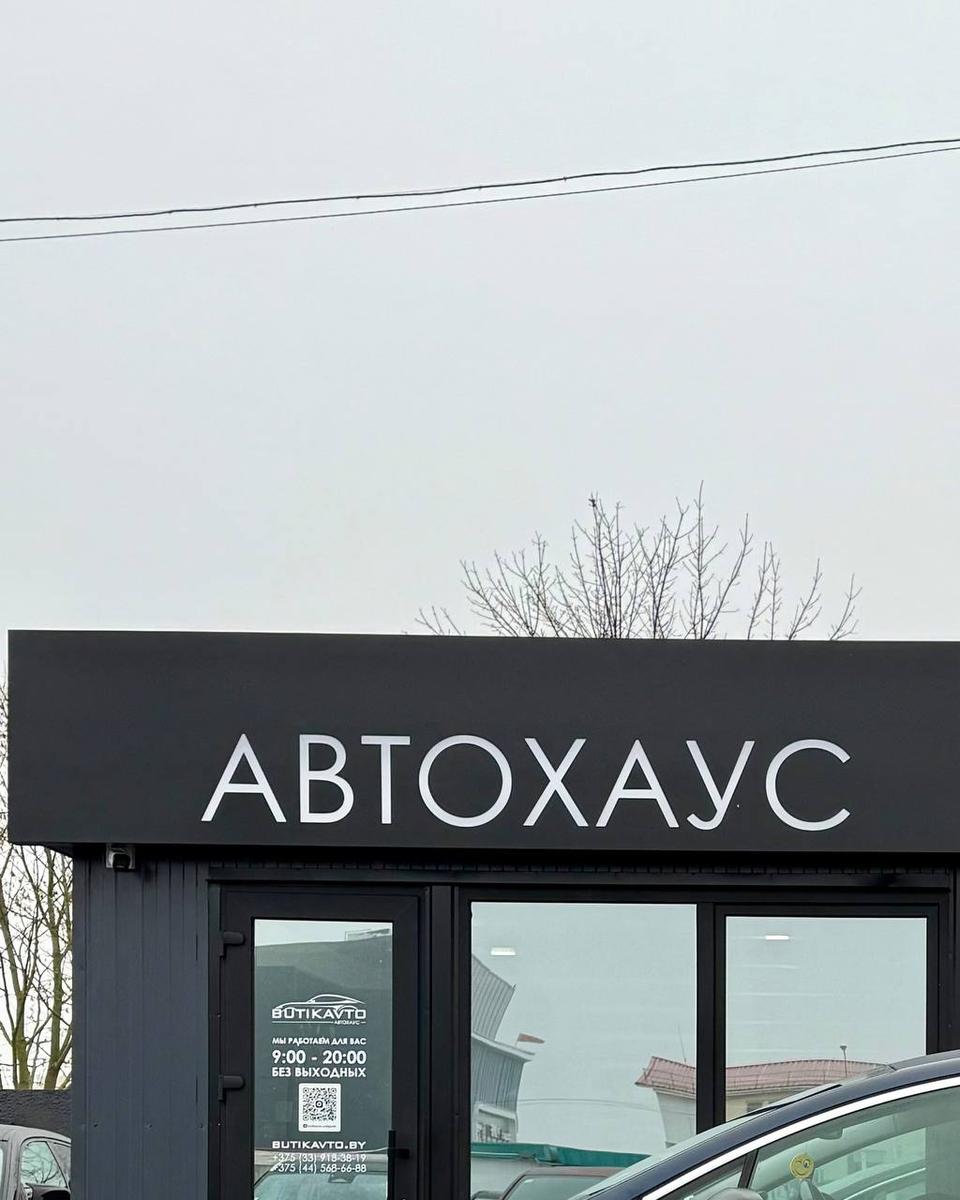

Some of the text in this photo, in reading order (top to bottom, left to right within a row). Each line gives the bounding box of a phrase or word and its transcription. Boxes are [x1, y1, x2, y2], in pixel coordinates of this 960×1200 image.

[201, 733, 851, 831] АВТОХАУС
[272, 1008, 366, 1019] BUTIKAVTO
[272, 1037, 366, 1046] МЫ РАБОТАЕМ ДЛЯ ВАС
[272, 1050, 306, 1064] 9:00
[322, 1050, 367, 1064] 20:00
[272, 1067, 366, 1078] БЕЗ ВЫХОДНЫХ
[272, 1141, 366, 1149] BUTIKAVTO.BY
[320, 1153, 366, 1162] 918-38-19
[299, 1163, 317, 1174] (44)
[320, 1163, 367, 1172] 568-66-88
